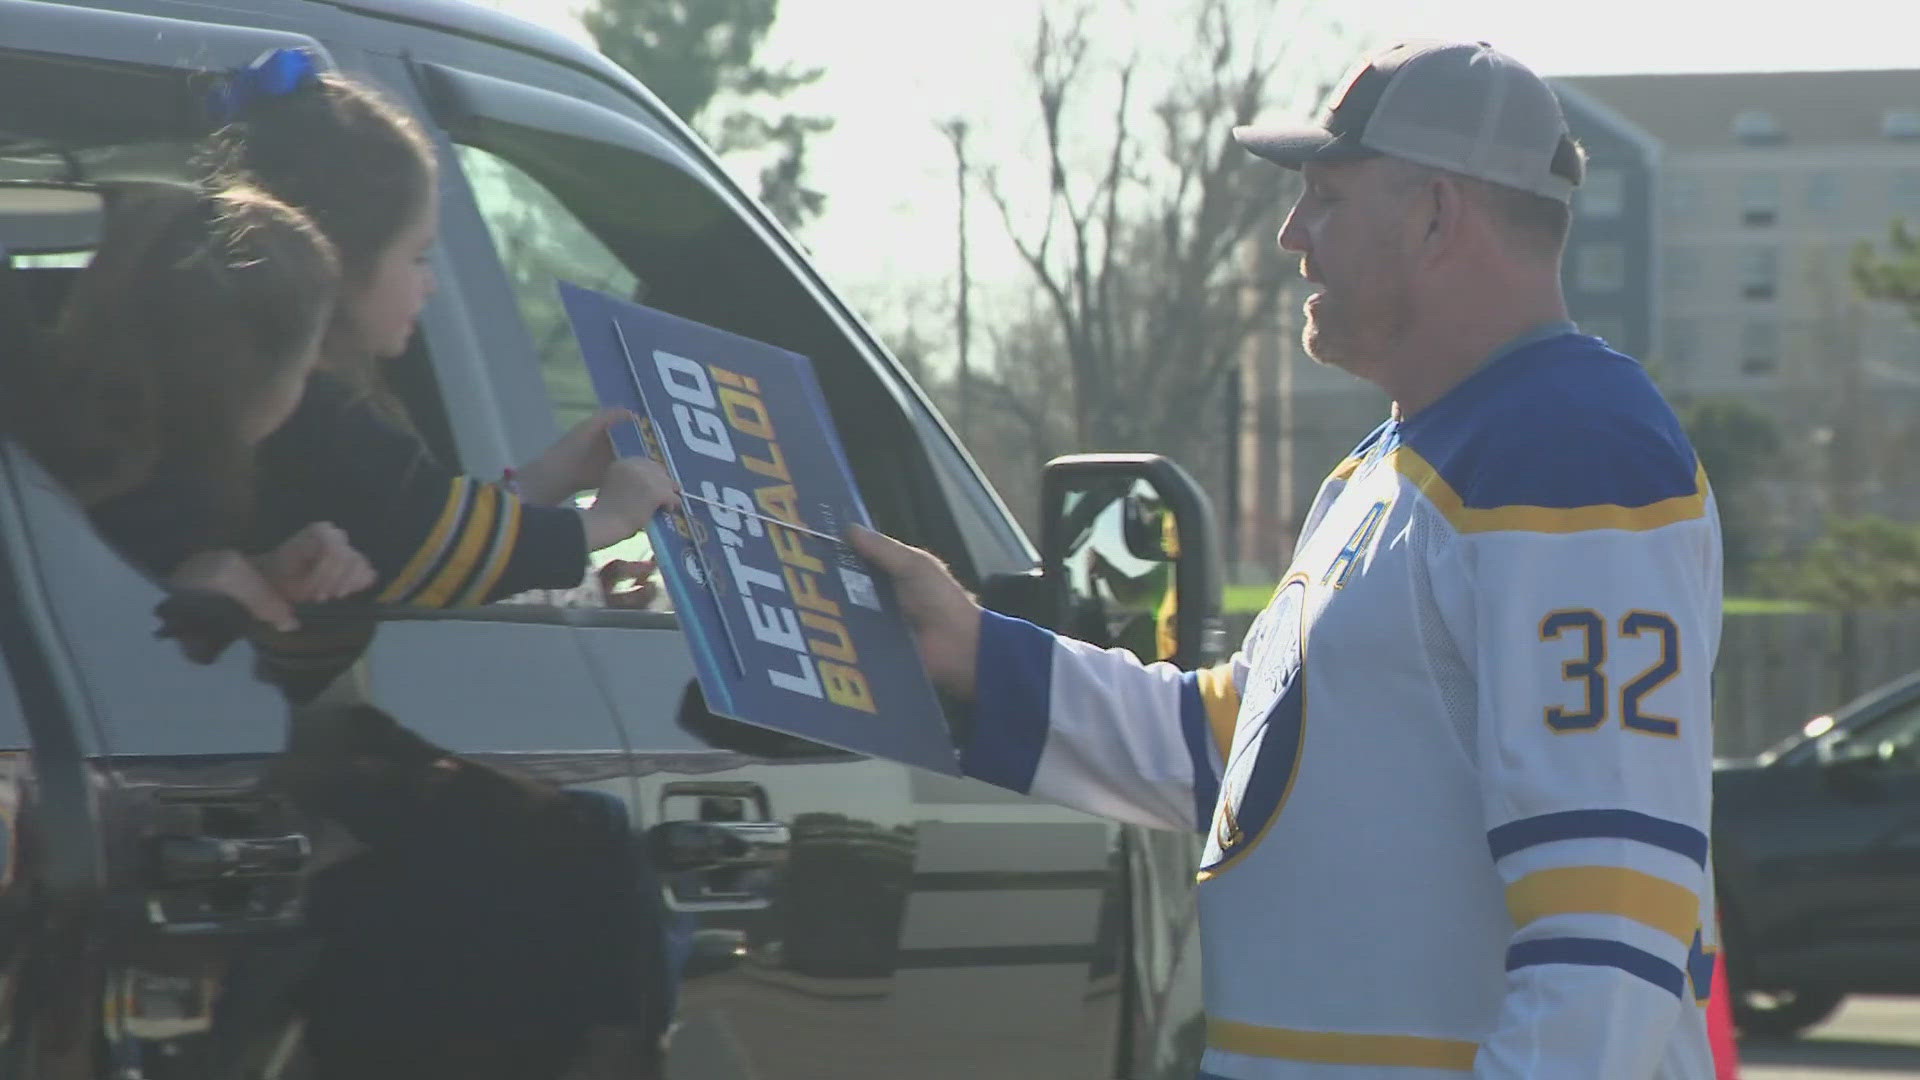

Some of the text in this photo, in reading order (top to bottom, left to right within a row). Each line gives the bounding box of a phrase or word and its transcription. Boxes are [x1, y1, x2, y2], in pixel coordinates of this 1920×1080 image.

[652, 349, 736, 463] GO
[700, 480, 825, 700] LET'S
[705, 364, 877, 715] BUFFALO!
[1321, 499, 1389, 590] A
[1538, 608, 1681, 739] 32
